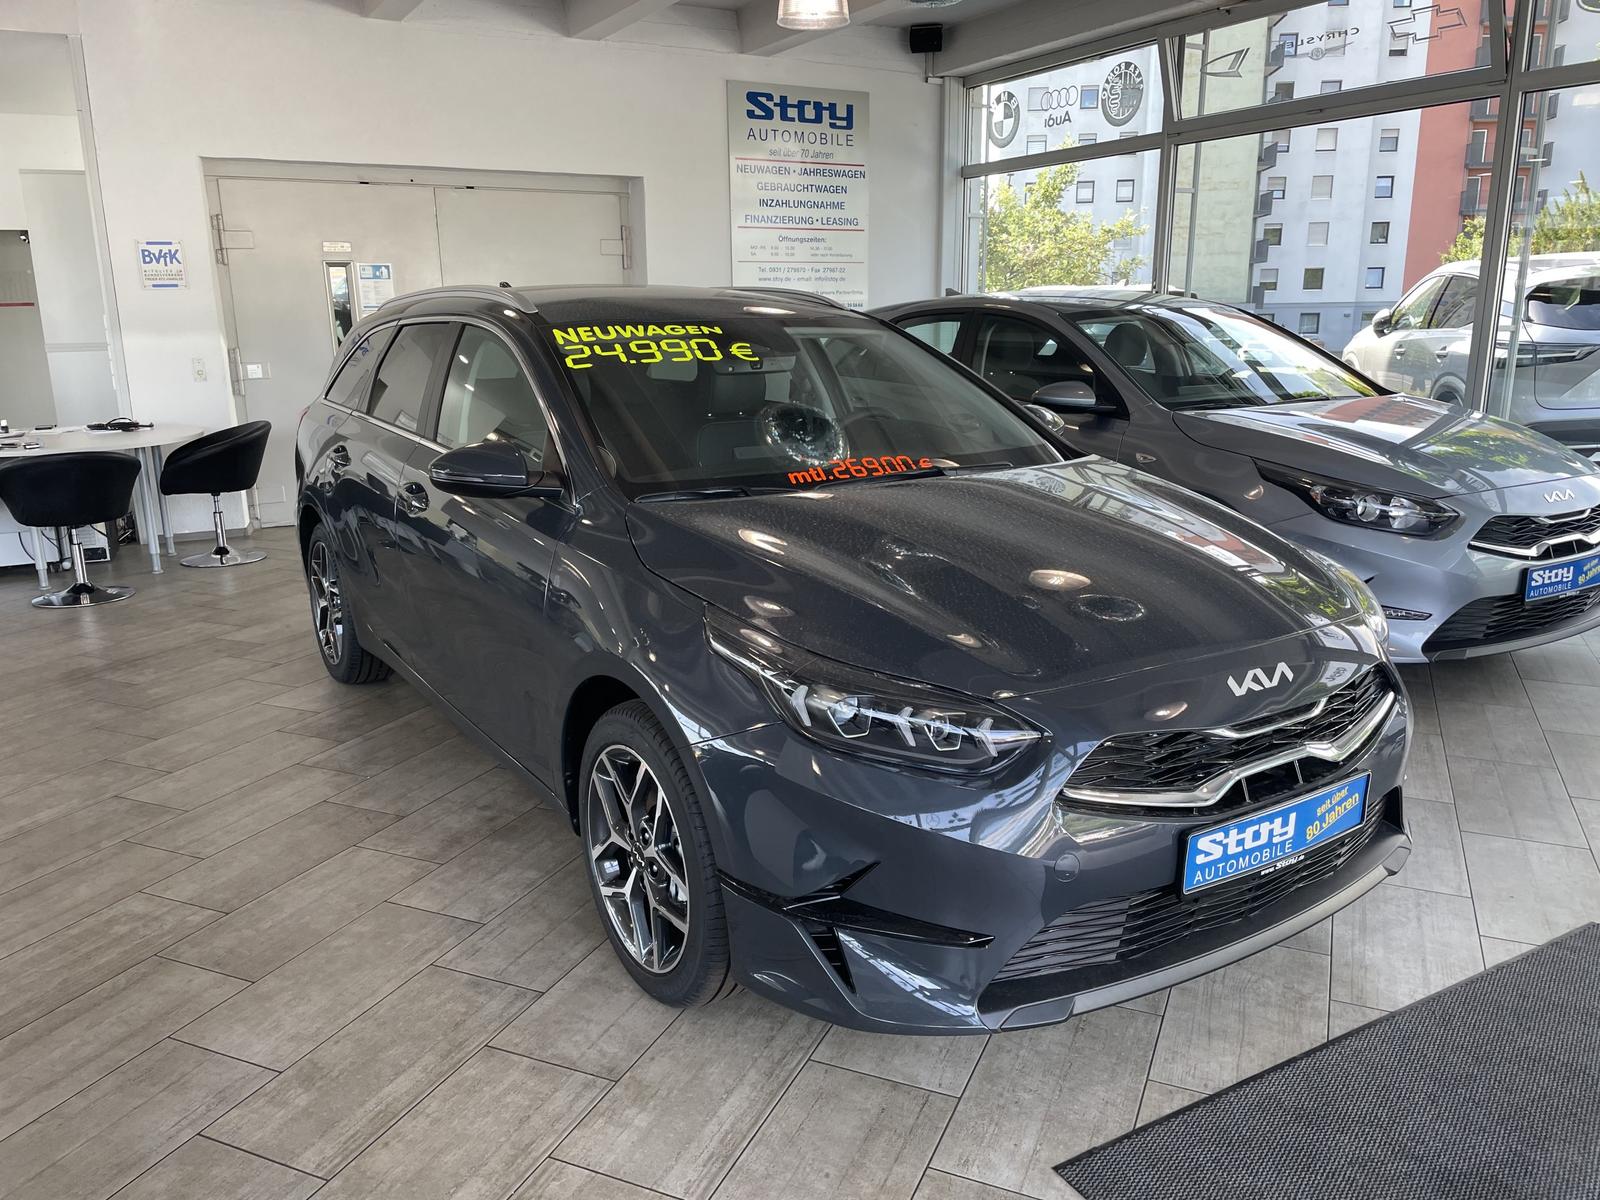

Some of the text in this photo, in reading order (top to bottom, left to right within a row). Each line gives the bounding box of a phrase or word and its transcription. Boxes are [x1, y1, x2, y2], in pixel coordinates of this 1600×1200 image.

[746, 91, 854, 130] Stoy
[747, 127, 855, 147] AUTOMOBILE
[800, 148, 810, 158] 70
[811, 149, 834, 159] Jahren
[736, 164, 866, 179] NEUWAGEN JAHRESWAGEN
[757, 182, 848, 194] GEBRAUCHTWAGEN
[759, 198, 846, 210] INZAHLUNGNAHME
[744, 214, 859, 227] FINANZIERUNG LEASING
[141, 249, 182, 267] BVfK
[552, 325, 723, 345] NEUWAGEN
[564, 339, 759, 369] 24.990 €
[1531, 566, 1574, 587] Stoy
[1529, 582, 1572, 597] AUTOMOBILE
[1227, 661, 1293, 697] KIA
[1316, 786, 1349, 817] seit über
[1306, 793, 1360, 840] 80 Jahren
[1196, 812, 1297, 864] Stoy
[1193, 840, 1293, 885] AUTOMOBILE
